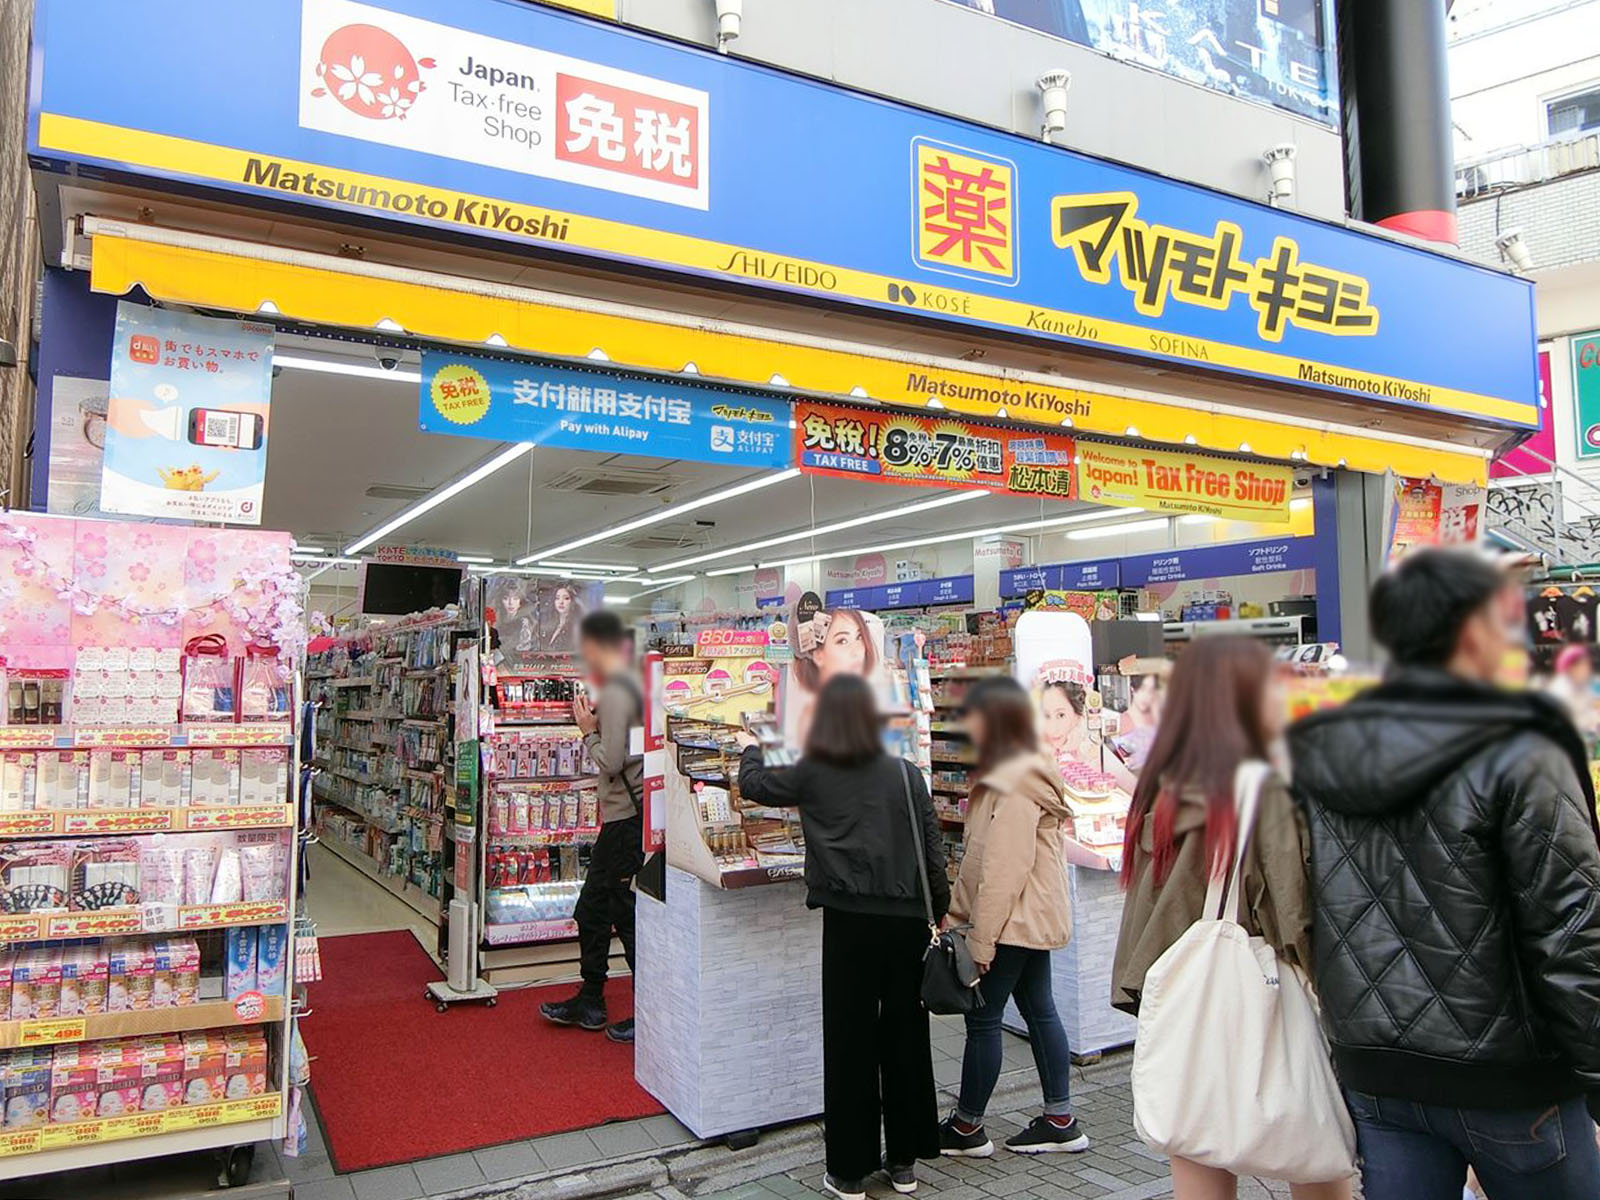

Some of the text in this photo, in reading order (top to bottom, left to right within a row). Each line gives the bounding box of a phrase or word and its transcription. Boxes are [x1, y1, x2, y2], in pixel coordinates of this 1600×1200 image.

[484, 118, 542, 148] Shop
[565, 93, 692, 178] 免税
[243, 158, 570, 241] Matsumoto KiYoshi
[923, 156, 1007, 270] 薬
[717, 250, 837, 290] SHISEIDO
[1060, 200, 1374, 333] マツモトキヨシ
[923, 291, 970, 315] KOSÉ
[1025, 310, 1099, 340] Kanebo
[164, 340, 259, 361] 街でもスマホで
[1149, 334, 1209, 359] SOFINA
[440, 376, 480, 400] 免税
[906, 373, 1091, 416] Matsumoto KiYoshi
[1298, 363, 1431, 404] Matsumoto KiYoshi
[443, 398, 485, 411] TAX FREE
[513, 379, 691, 425] 支付就用支付宝
[560, 420, 649, 441] Pay with Alipay
[736, 430, 774, 447] 支付宝
[738, 446, 773, 454] ALIPAY
[976, 439, 1000, 455] 折扣
[1082, 450, 1137, 468] Welcome to
[814, 453, 869, 471] TAX FREE
[1009, 466, 1069, 493] 松本清
[1087, 464, 1138, 486] Japan!
[1142, 459, 1285, 504] Tax Free Shop
[1159, 501, 1197, 512] Matsumoto
[377, 545, 406, 554] KATE
[1249, 545, 1288, 556] ソフトドリンク
[237, 832, 277, 843] 数量限定
[54, 1029, 82, 1038] 498
